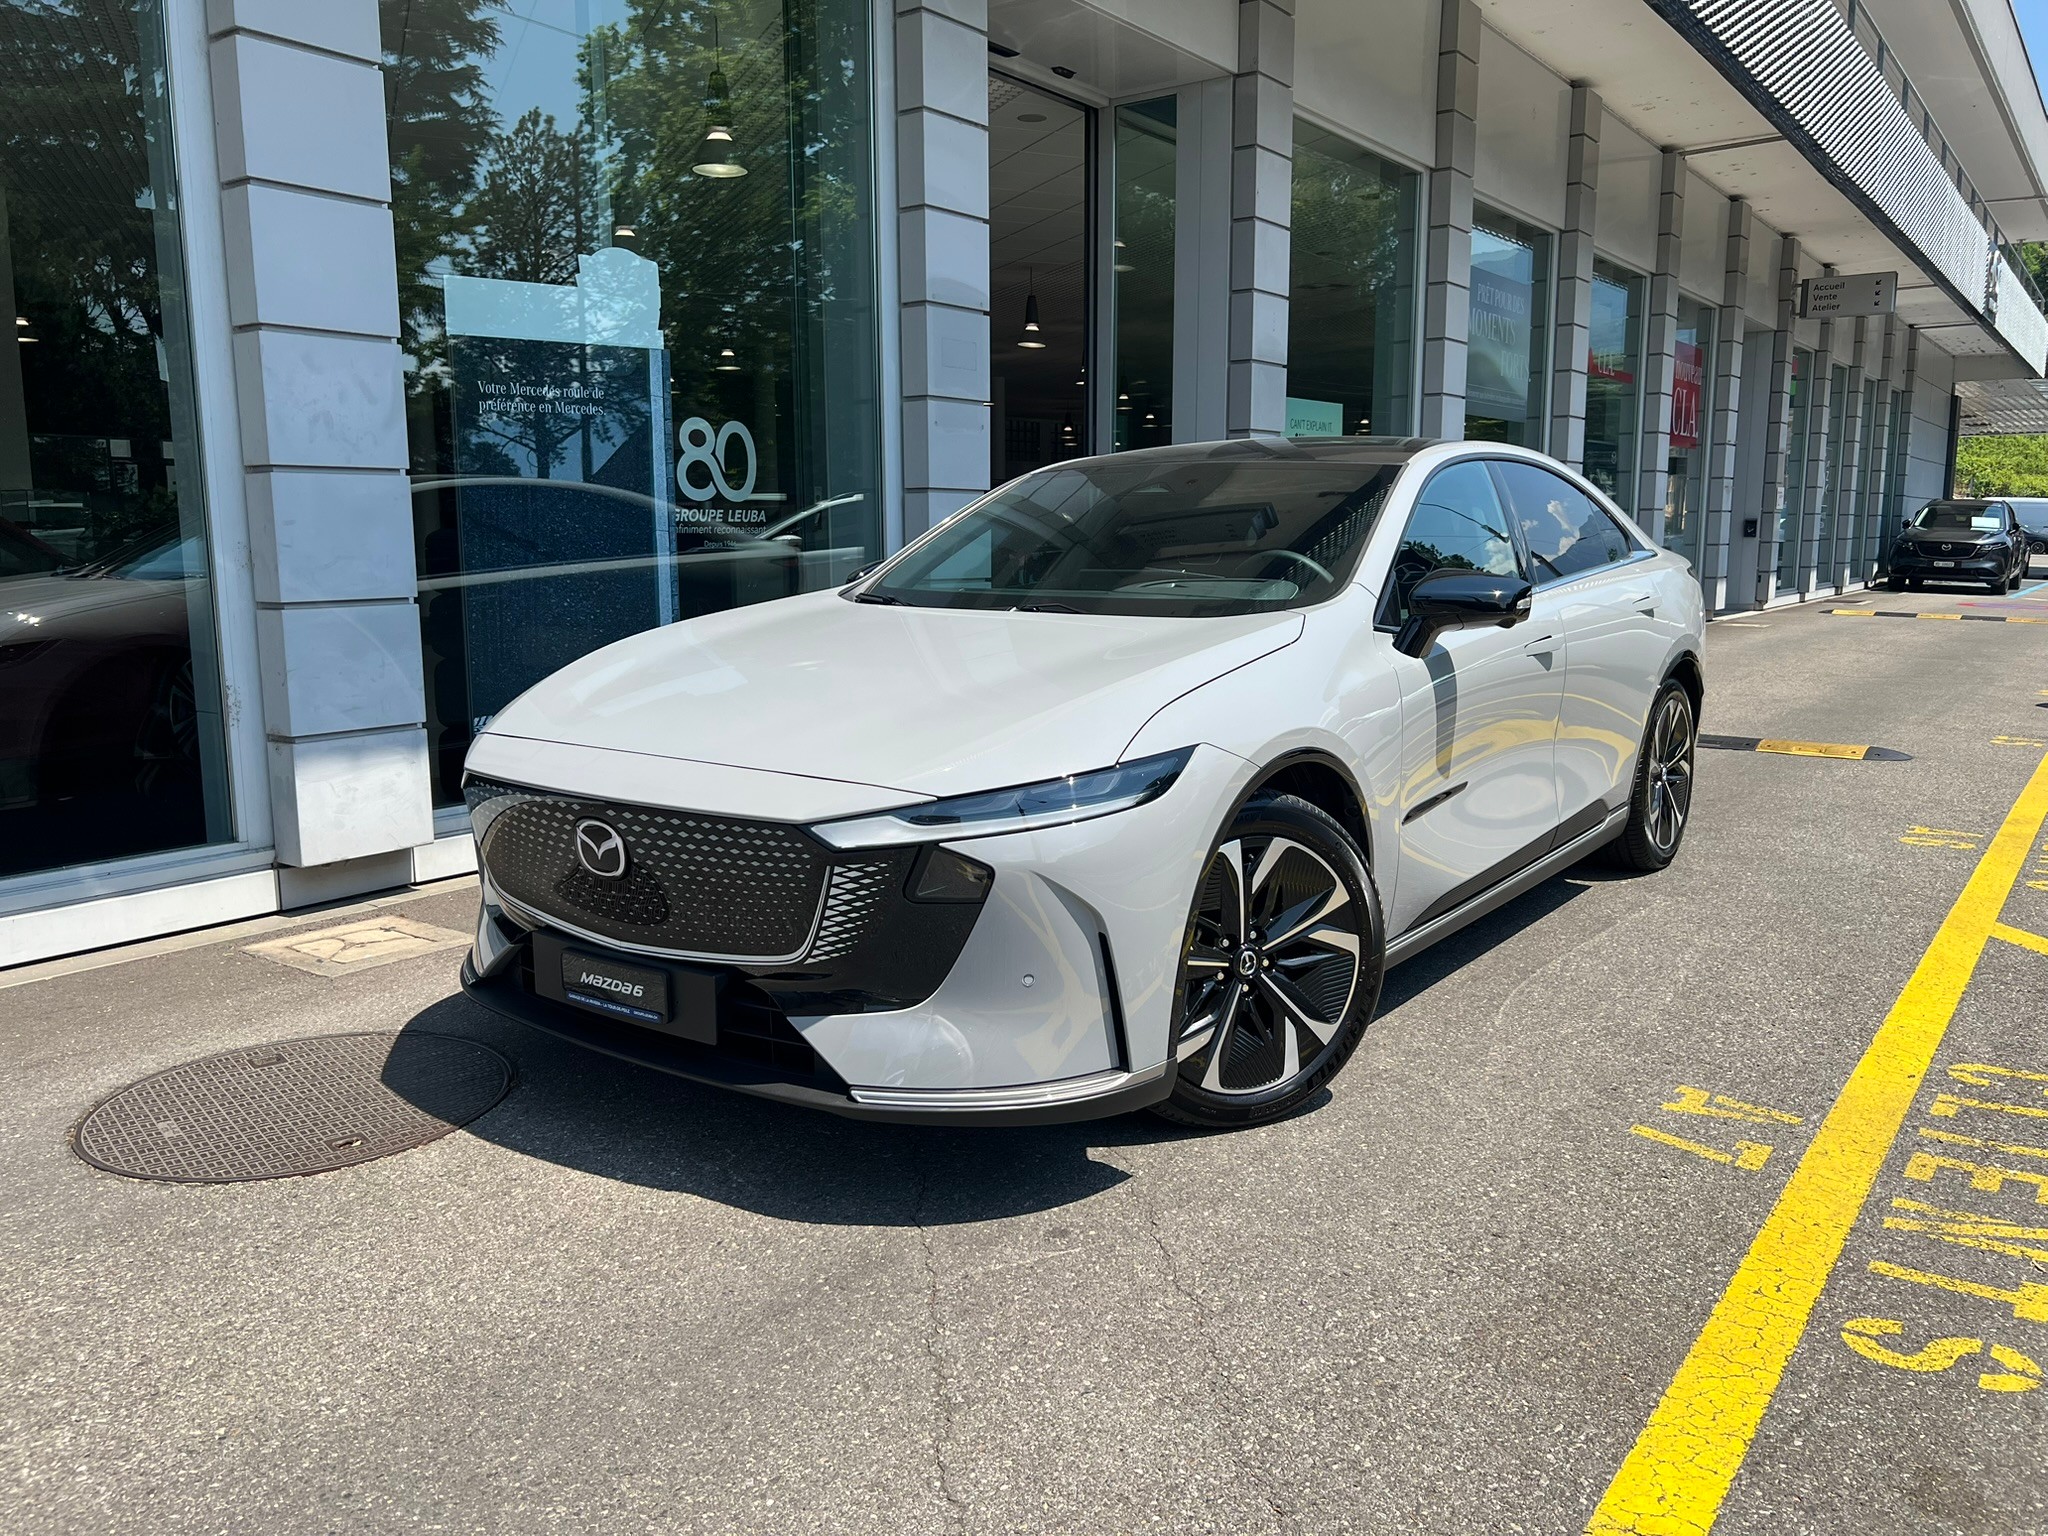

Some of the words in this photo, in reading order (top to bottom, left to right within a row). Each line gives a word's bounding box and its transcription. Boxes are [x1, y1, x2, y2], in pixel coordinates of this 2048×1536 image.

[1813, 282, 1845, 291] Accueil
[1813, 293, 1838, 301] Vente
[1812, 304, 1840, 312] Atelier
[478, 380, 507, 395] Votre
[563, 386, 590, 399] roule
[592, 387, 605, 400] de
[479, 398, 537, 414] préférence
[538, 403, 552, 413] en
[555, 401, 607, 416] Mercedes.
[677, 417, 757, 502] 80
[728, 510, 767, 522] LEUBA
[714, 525, 767, 535] reconnaissant
[1630, 1084, 1802, 1171] 47
[1841, 1062, 2048, 1392] CLIENTS
